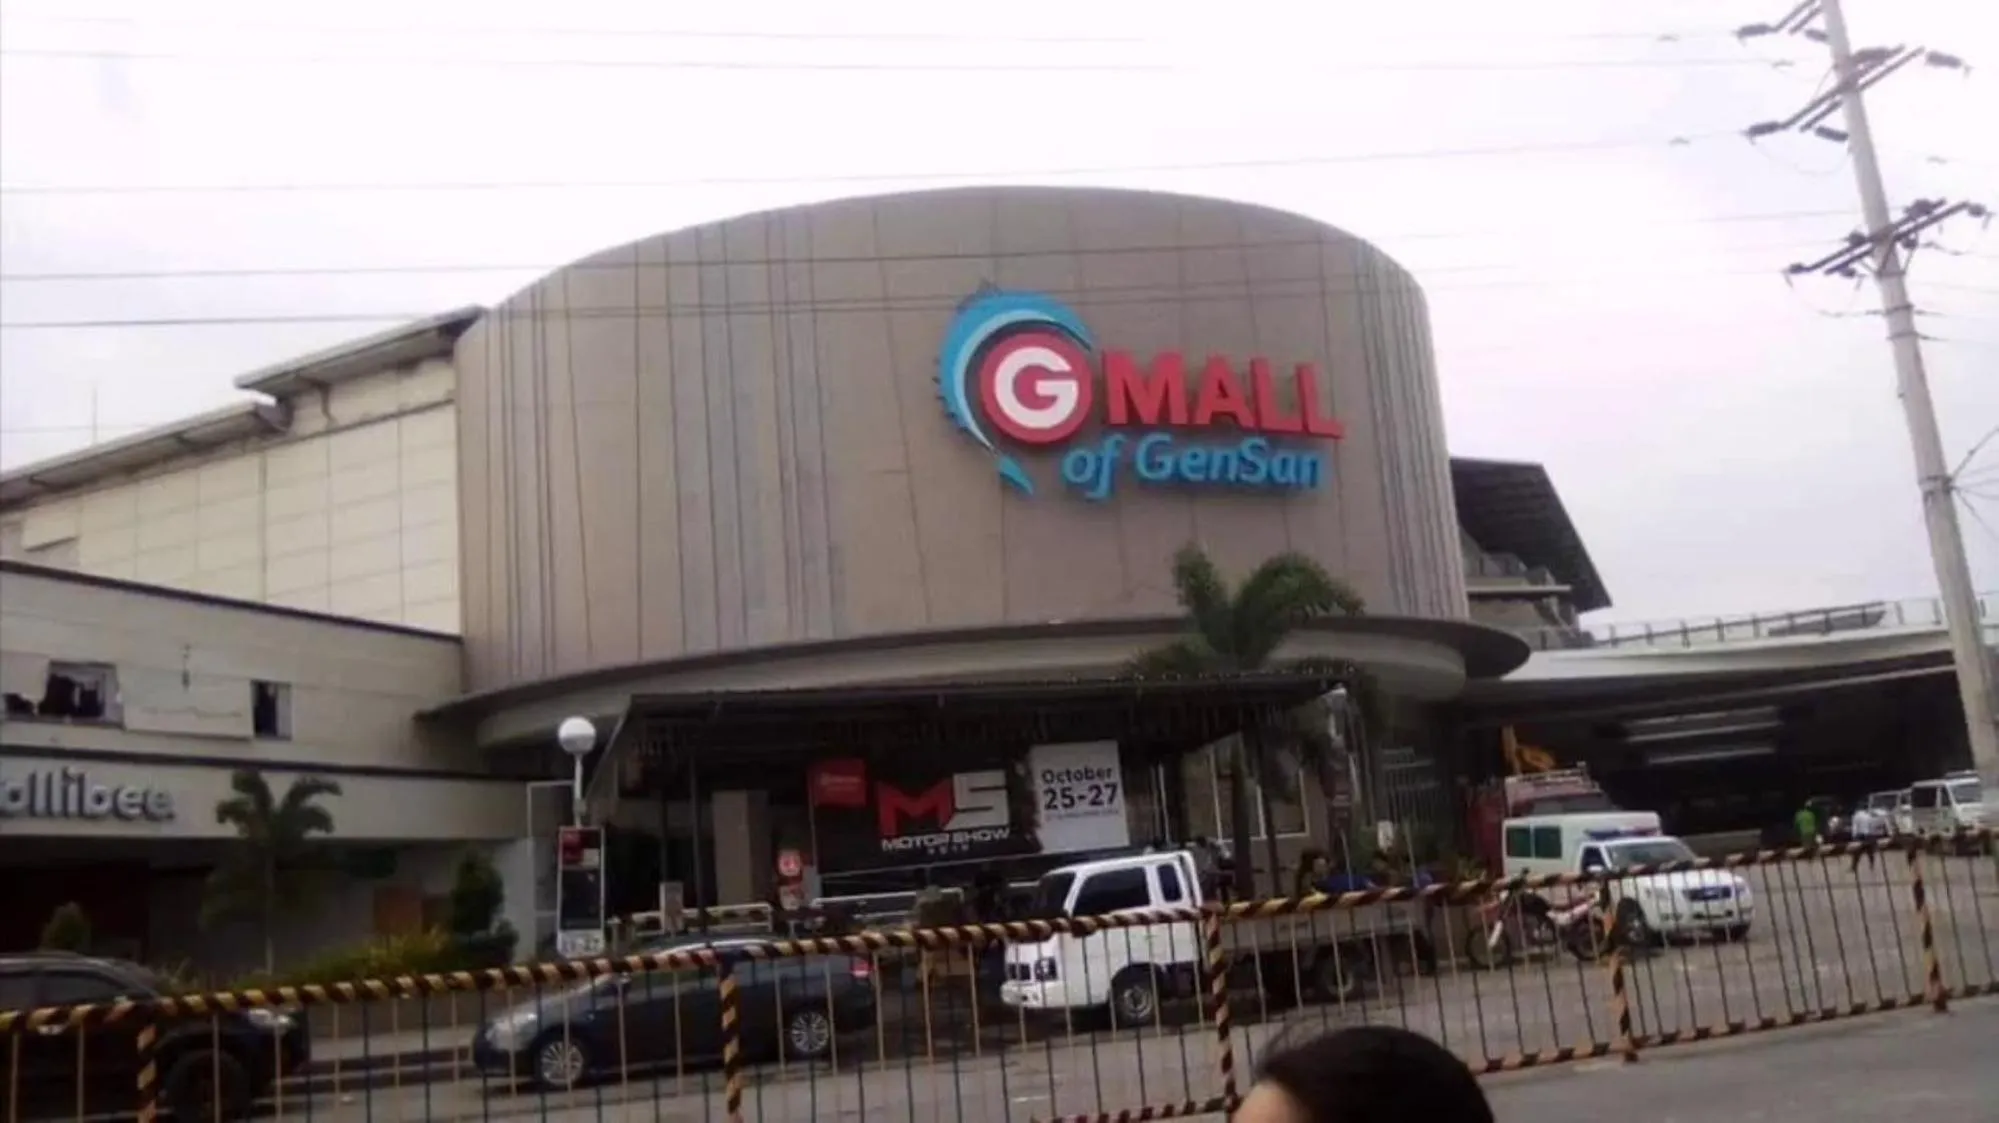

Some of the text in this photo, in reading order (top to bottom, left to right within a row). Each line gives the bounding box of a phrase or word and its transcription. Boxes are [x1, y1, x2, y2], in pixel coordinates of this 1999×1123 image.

[993, 345, 1345, 439] G MALL
[1061, 432, 1327, 500] of GenSan
[1042, 765, 1112, 784] October
[1043, 783, 1118, 810] 25-27
